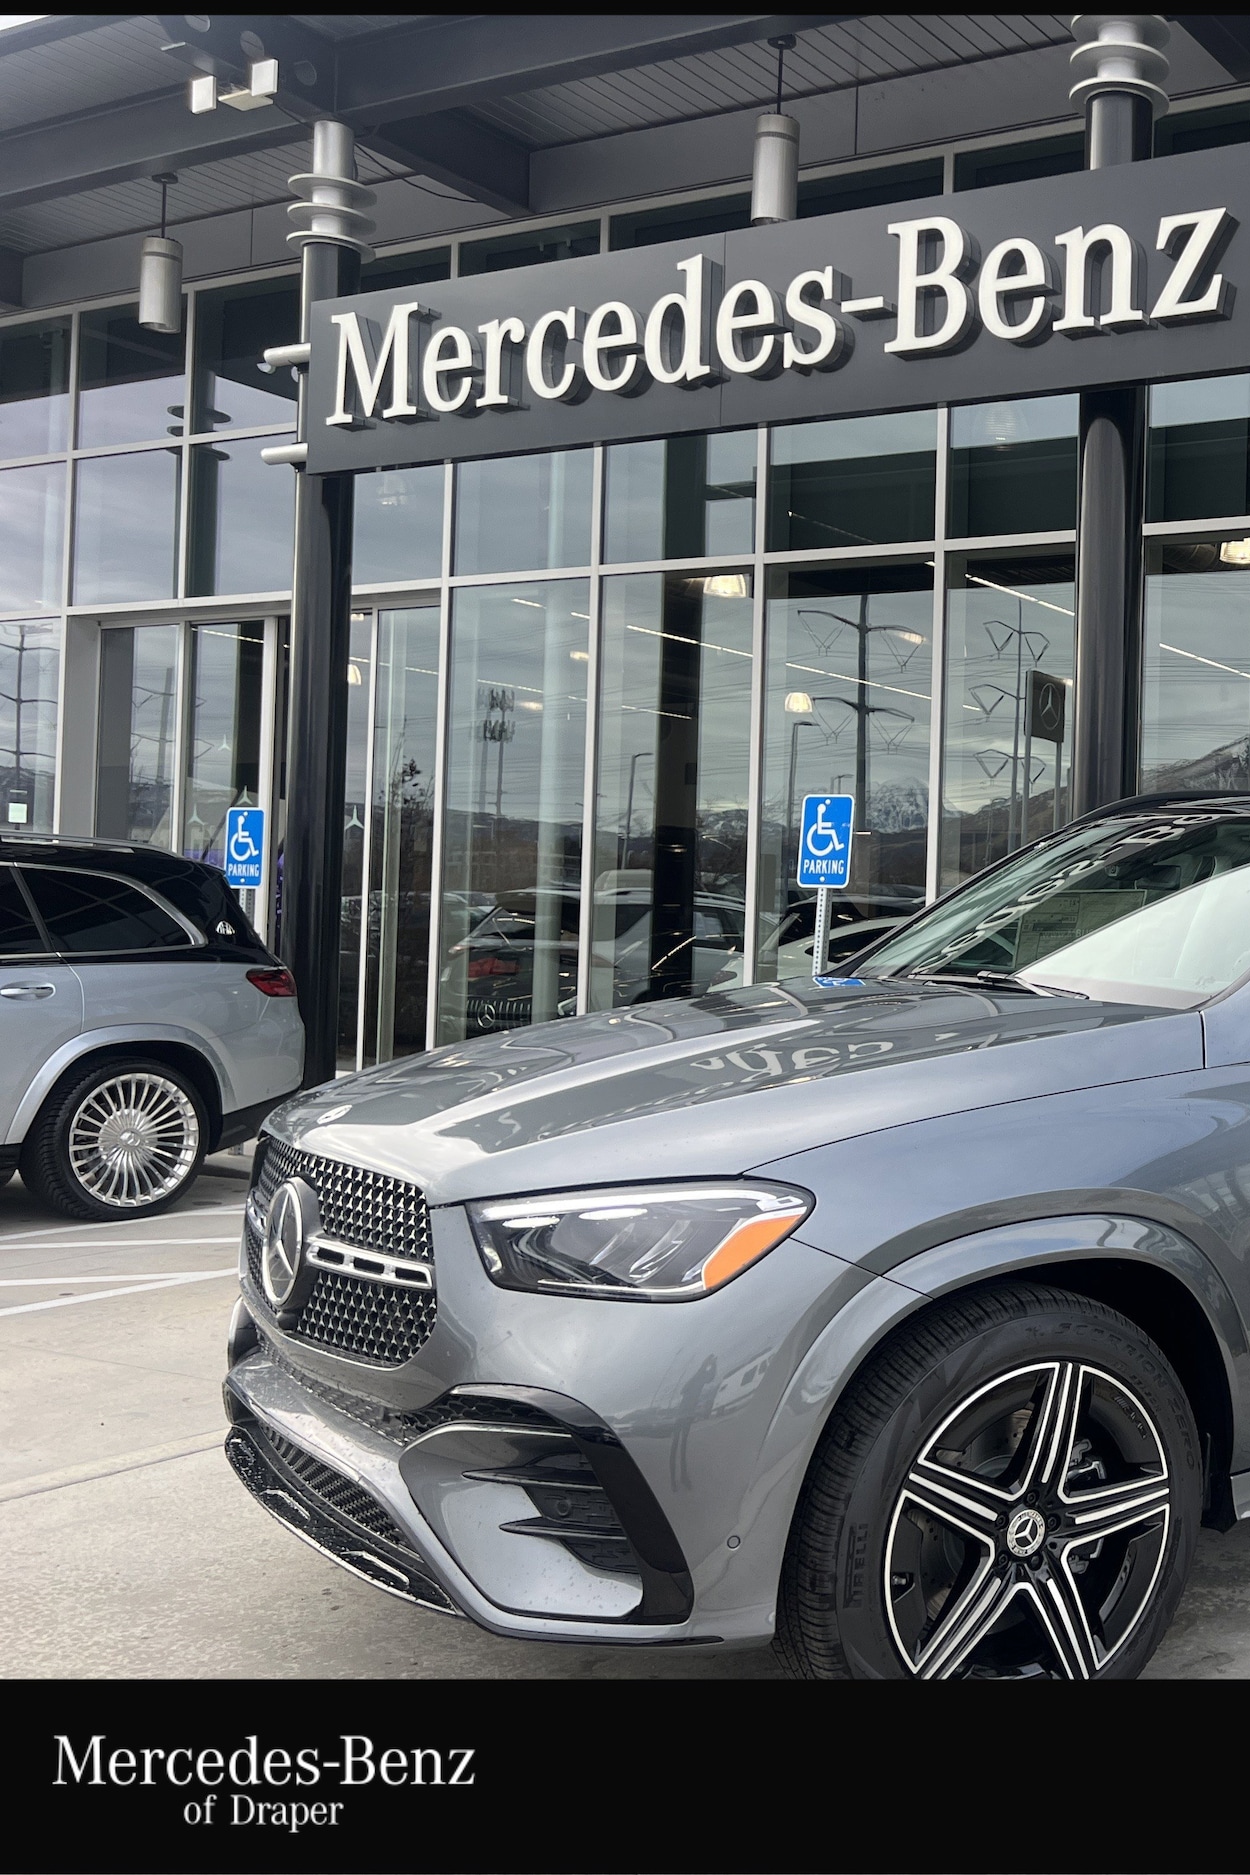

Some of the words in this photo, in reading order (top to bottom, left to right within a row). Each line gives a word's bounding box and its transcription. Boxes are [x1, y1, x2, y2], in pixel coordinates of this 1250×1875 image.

[326, 207, 1231, 428] Mercedes-Benz
[227, 863, 260, 877] PARKING
[801, 857, 847, 877] PARKING
